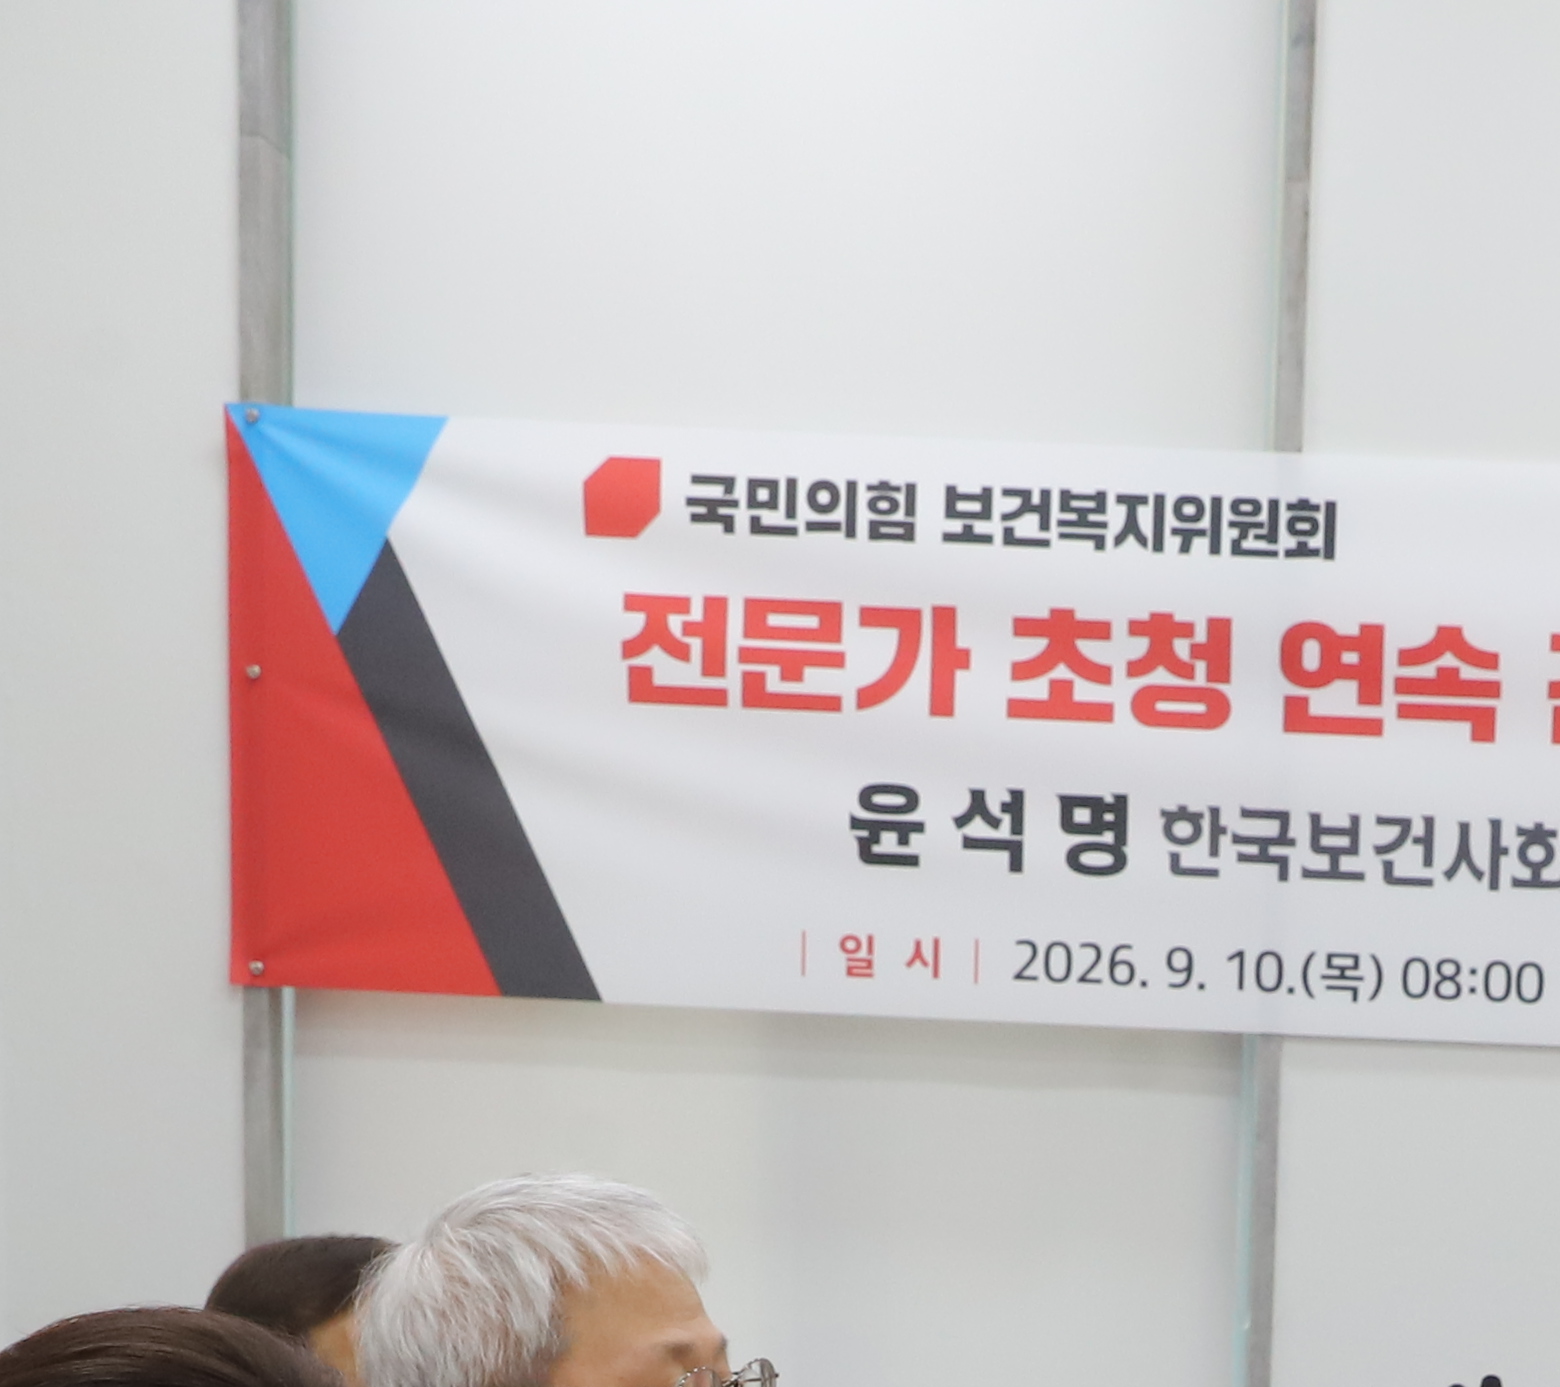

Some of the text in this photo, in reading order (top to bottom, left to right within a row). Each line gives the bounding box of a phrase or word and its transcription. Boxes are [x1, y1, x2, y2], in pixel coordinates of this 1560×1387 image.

[685, 473, 1338, 562] 국민의힘 보건복지위원회
[621, 591, 971, 719] 전문가
[1006, 608, 1233, 731] 초청
[1280, 617, 1501, 743] 연속
[1012, 937, 1150, 988] 2026.
[1165, 945, 1207, 991] 9.
[1226, 948, 1383, 1003] 10.(목)
[1400, 955, 1545, 1006] 08:00
